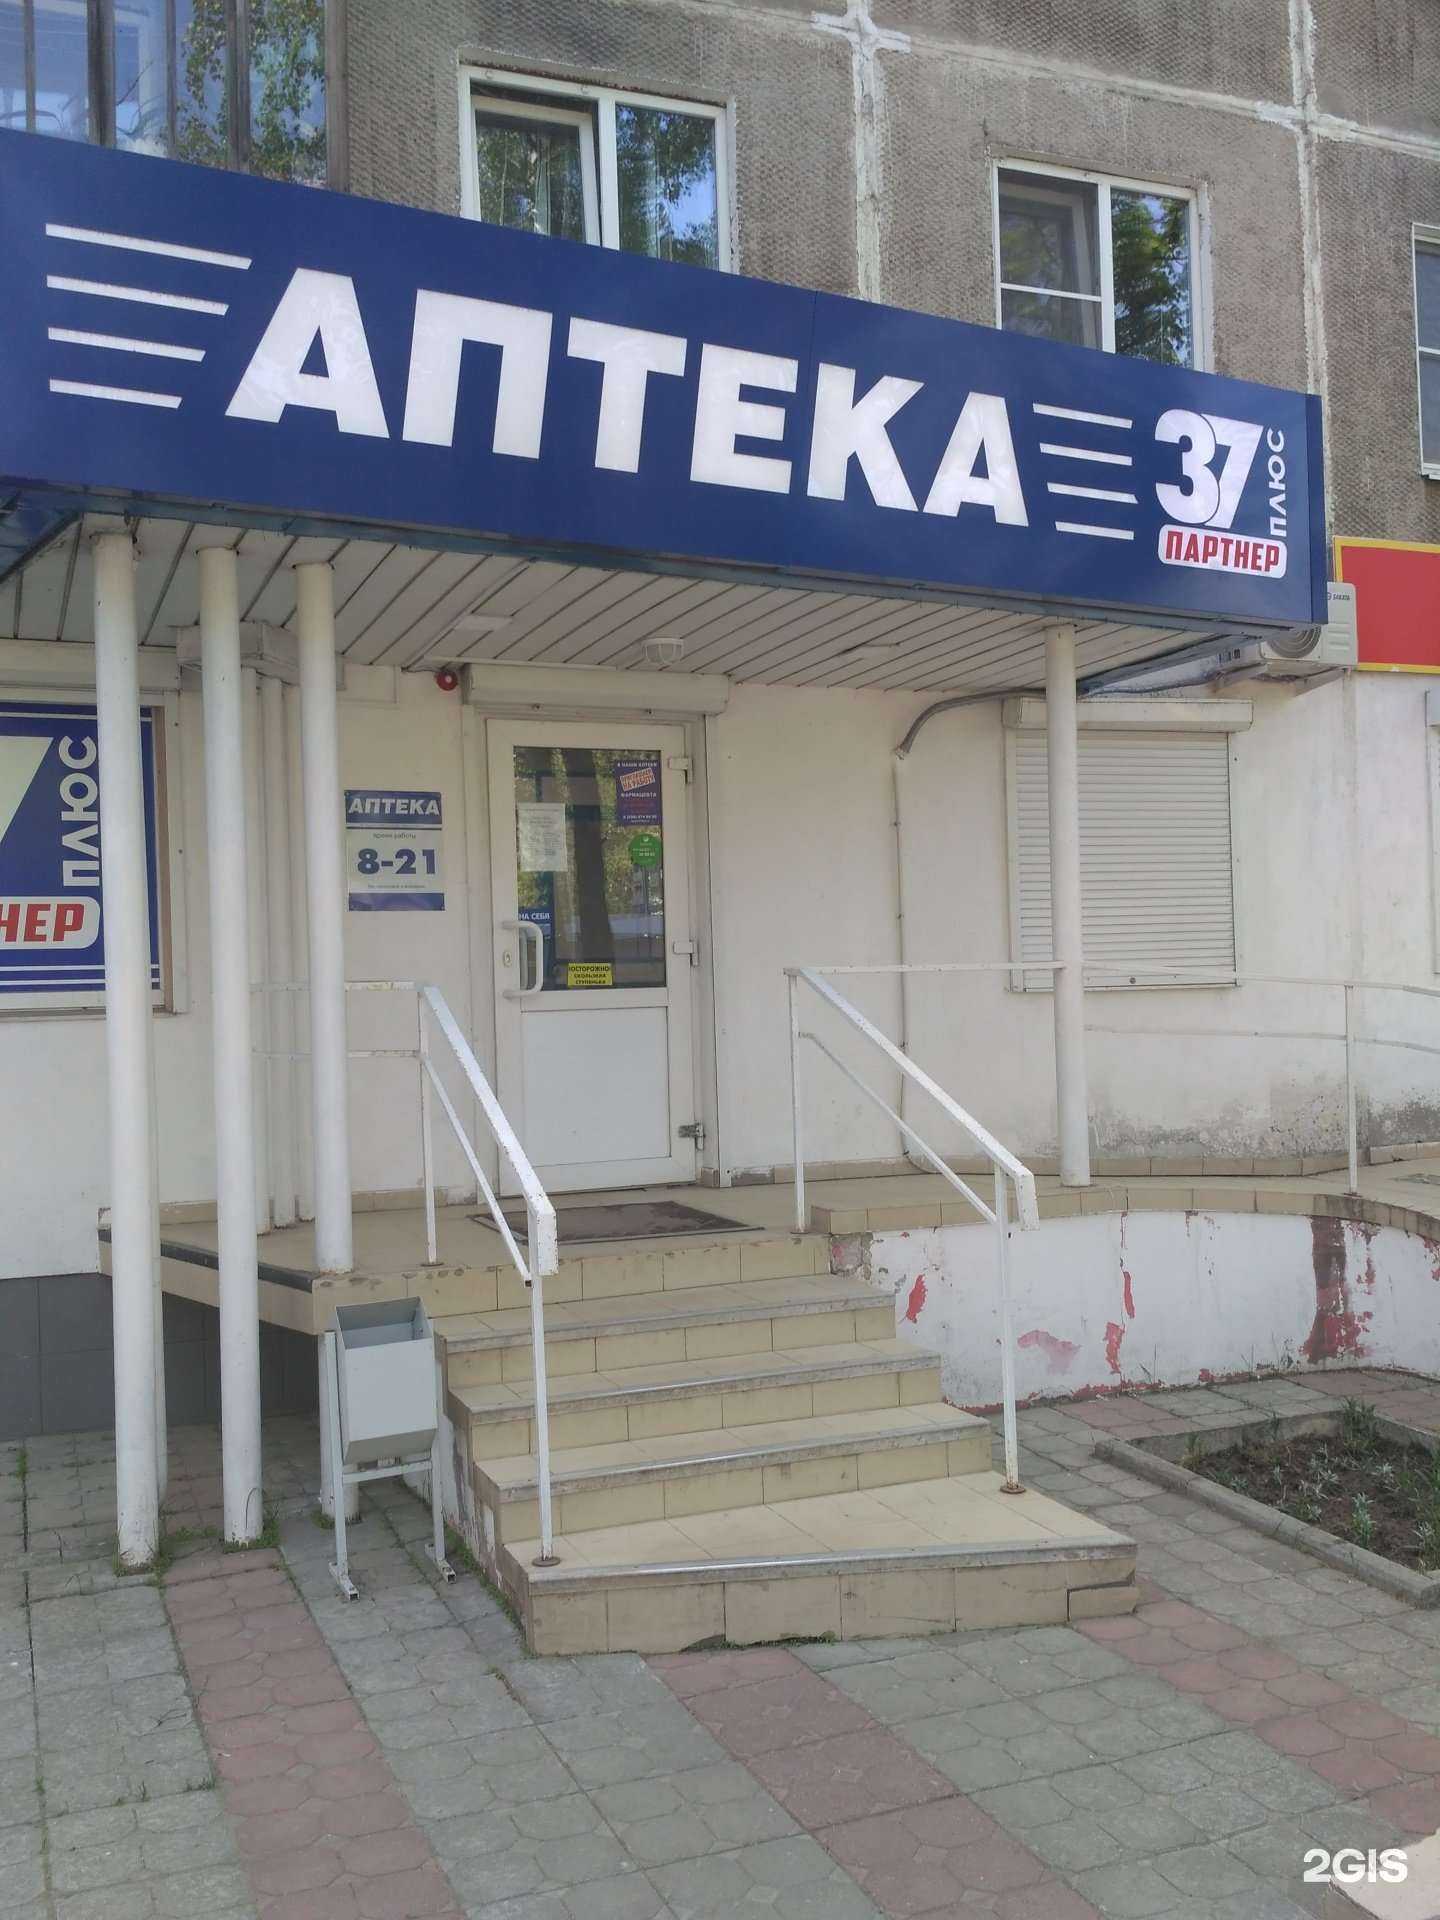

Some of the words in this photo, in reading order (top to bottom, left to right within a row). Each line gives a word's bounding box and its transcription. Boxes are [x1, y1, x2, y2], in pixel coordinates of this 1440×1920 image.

[225, 266, 1030, 528] АПТЕКА
[1154, 408, 1264, 529] 37
[1266, 427, 1288, 537] ПЛЮС
[1165, 530, 1281, 573] ПАРТНЕР
[58, 735, 101, 887] ПЛЮС
[348, 798, 440, 815] АПТЕКА
[357, 848, 436, 875] 8-21
